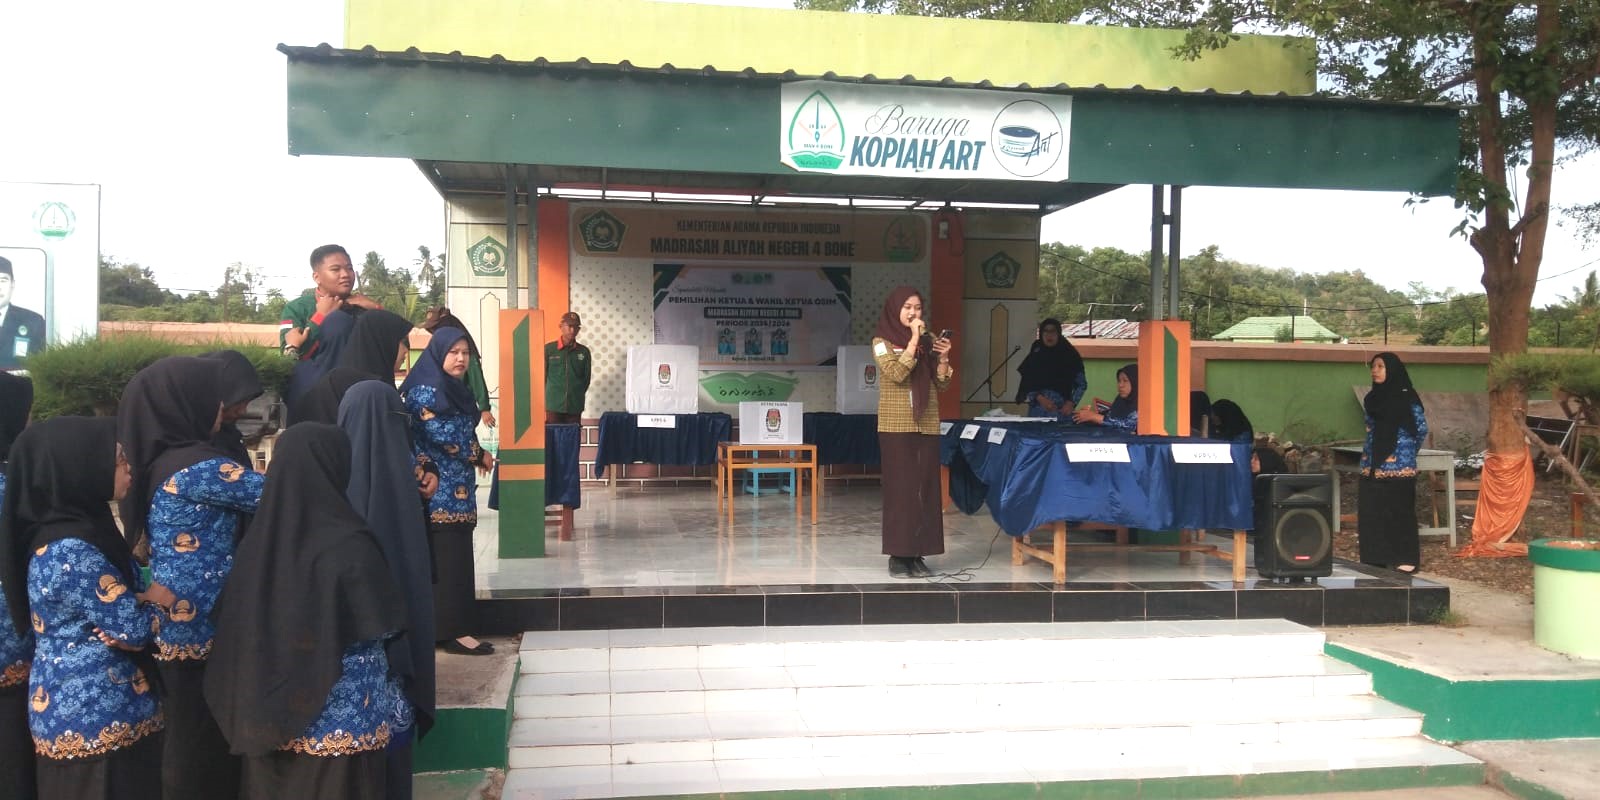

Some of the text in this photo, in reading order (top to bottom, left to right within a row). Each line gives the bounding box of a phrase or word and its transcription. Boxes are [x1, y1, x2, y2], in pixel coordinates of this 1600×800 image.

[865, 104, 970, 144] Baruga
[850, 136, 986, 171] KOPIAH ART
[677, 220, 841, 234] KEMENTERIAN AGAMA REPUBLIK INDONESIA
[650, 238, 855, 257] MADRASAH ALIYAH NEGERI 4 BONE
[669, 296, 716, 304] PEMILIHAN
[719, 296, 747, 304] KETUA
[756, 297, 784, 305] WAKIL
[785, 297, 813, 305] KETUA
[815, 297, 837, 305] OSIM
